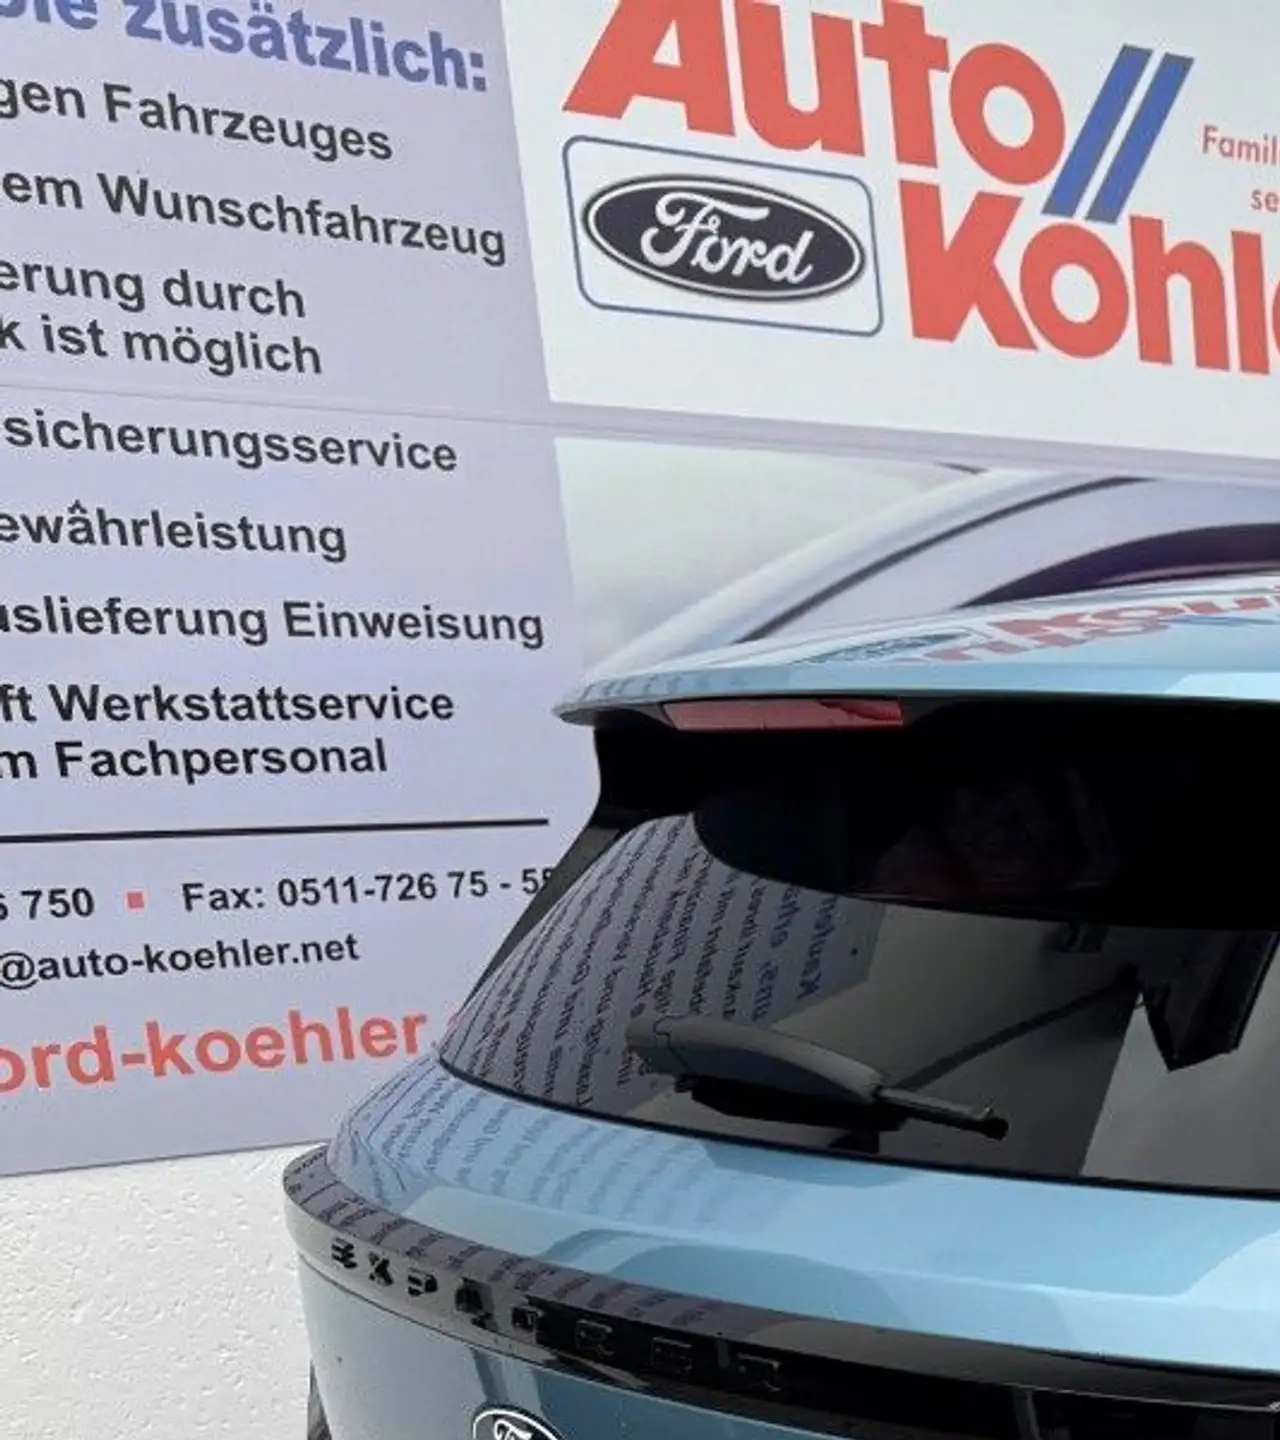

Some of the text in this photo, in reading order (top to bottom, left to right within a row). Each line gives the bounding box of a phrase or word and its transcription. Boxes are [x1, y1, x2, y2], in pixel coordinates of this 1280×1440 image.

[124, 0, 487, 92] zusätzlich:
[0, 78, 393, 162] gen Fahrzeuges
[562, 0, 1066, 187] Auto
[3, 171, 506, 267] em Wunschfahrzeug
[640, 190, 812, 284] Ford
[0, 260, 306, 318] erung durch
[40, 313, 108, 357] ist
[123, 326, 322, 377] möglich
[4, 408, 457, 472] sicherungsservice
[283, 601, 544, 648] Einweisung
[48, 684, 454, 722] Werkstattservice
[55, 738, 388, 784] Fachpersonal
[21, 887, 95, 919] 750
[182, 879, 264, 911] Fax:
[277, 873, 437, 907] 0511-726
[447, 870, 488, 898] 75
[0, 934, 360, 989] @auto-koehler.net
